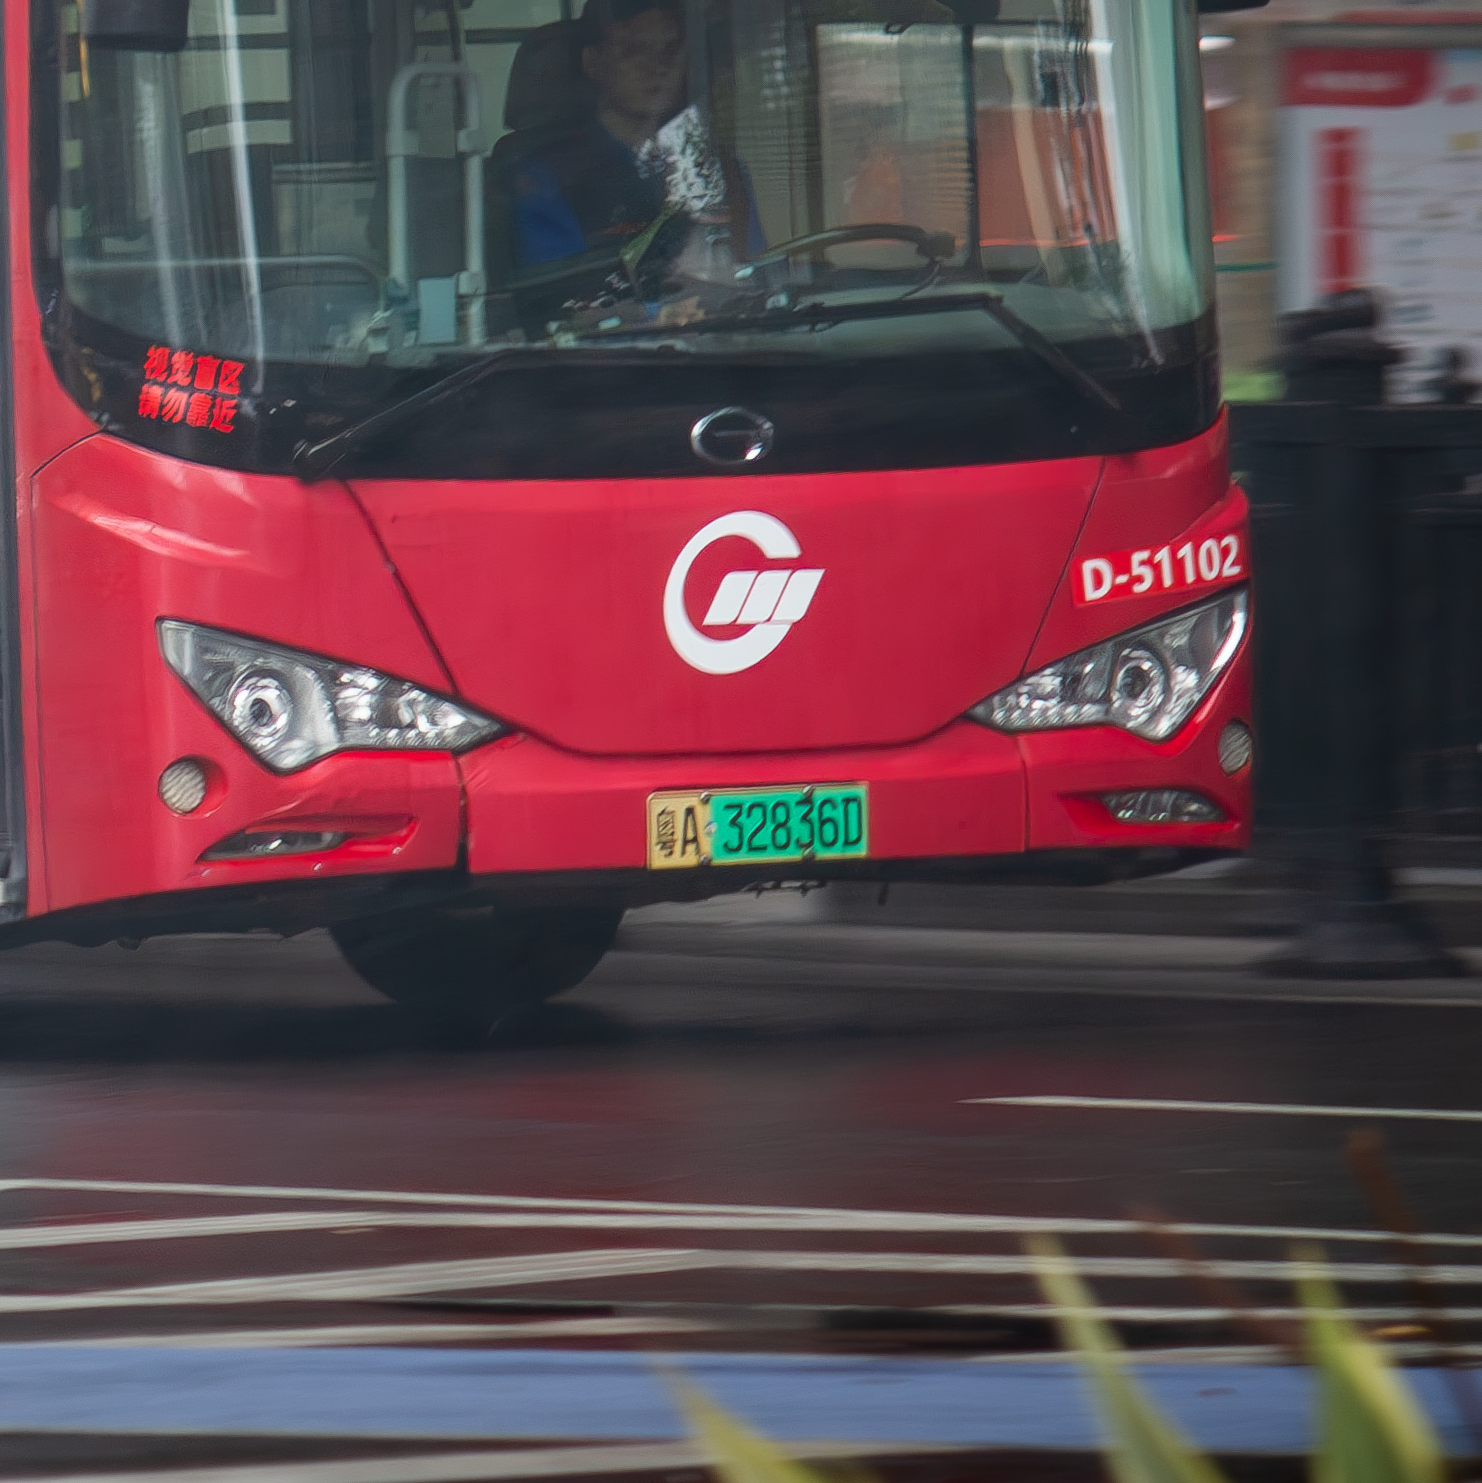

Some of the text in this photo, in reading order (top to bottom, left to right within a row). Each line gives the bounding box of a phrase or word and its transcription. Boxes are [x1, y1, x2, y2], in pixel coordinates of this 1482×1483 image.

[143, 346, 245, 396] 视觉盲区
[139, 383, 238, 434] 请勿靠近
[1082, 534, 1241, 602] D-51102
